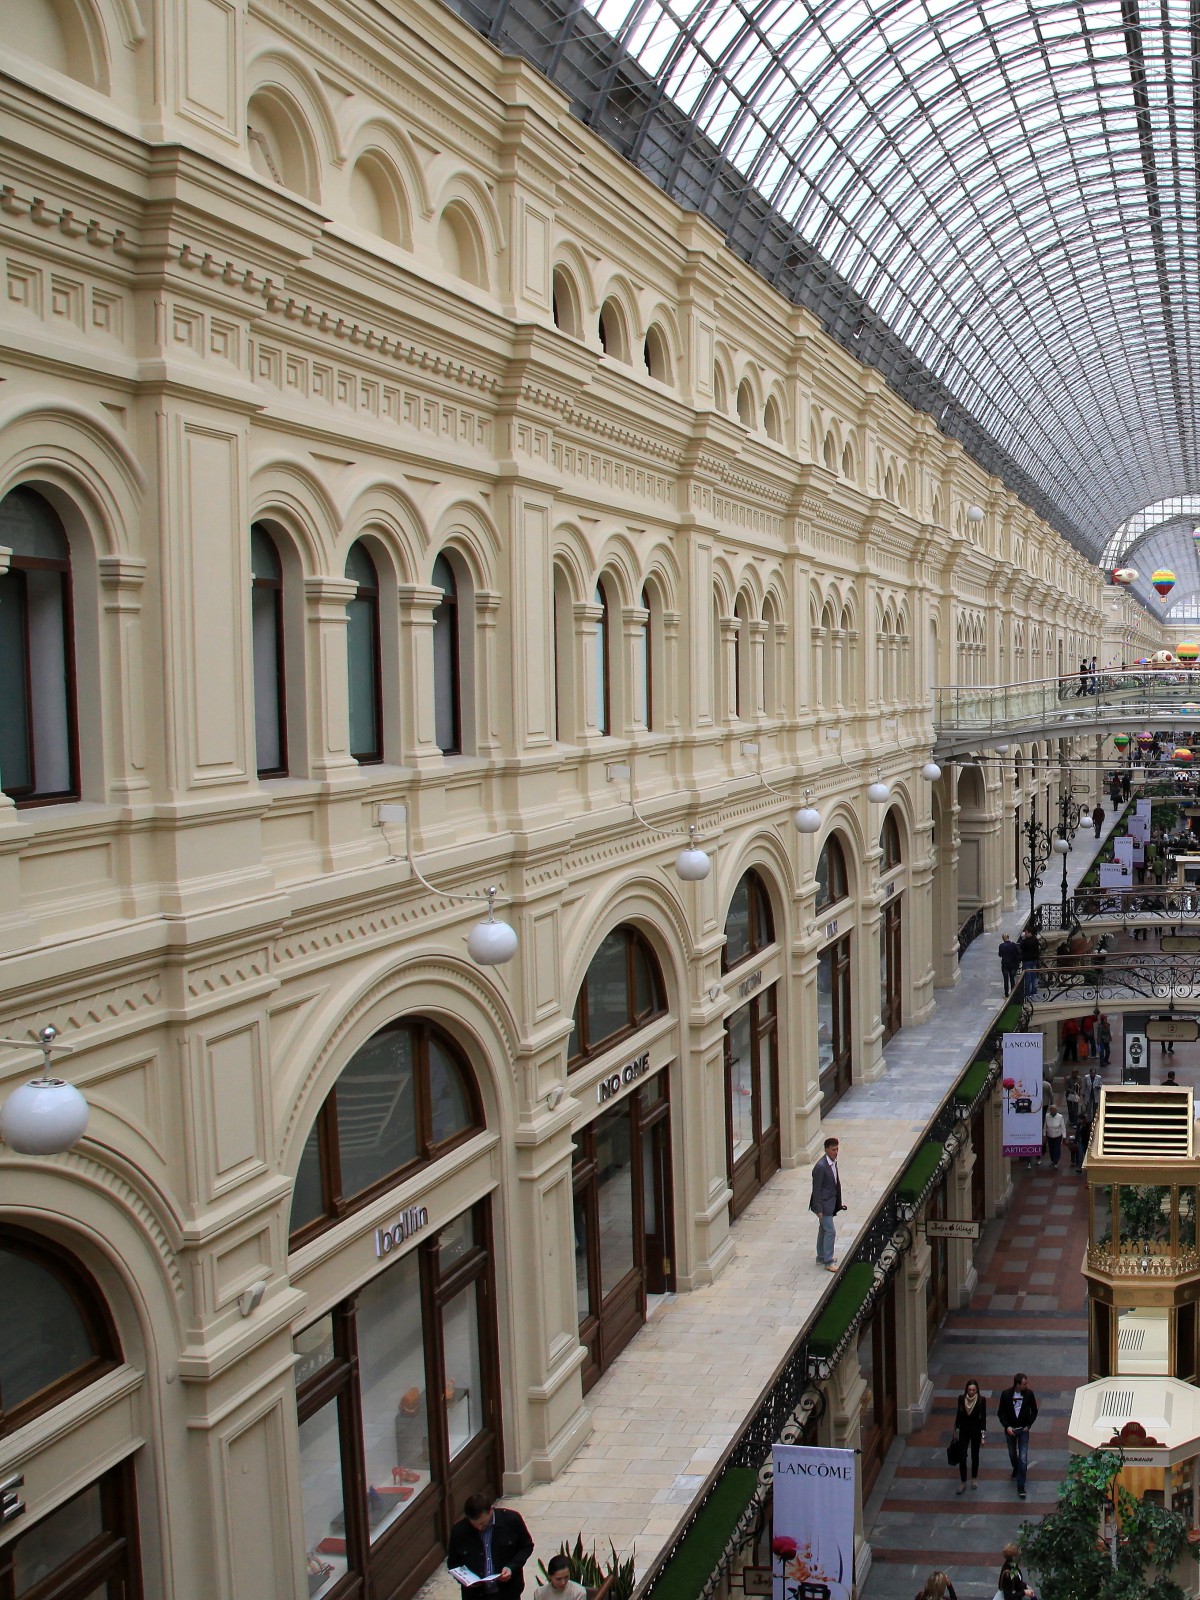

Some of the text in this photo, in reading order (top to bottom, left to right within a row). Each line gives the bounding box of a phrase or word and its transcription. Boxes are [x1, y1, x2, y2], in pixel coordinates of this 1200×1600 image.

[1004, 1040, 1041, 1048] LANCÔME
[597, 1051, 651, 1104] NO ONE
[777, 1462, 852, 1480] LANCÔME
